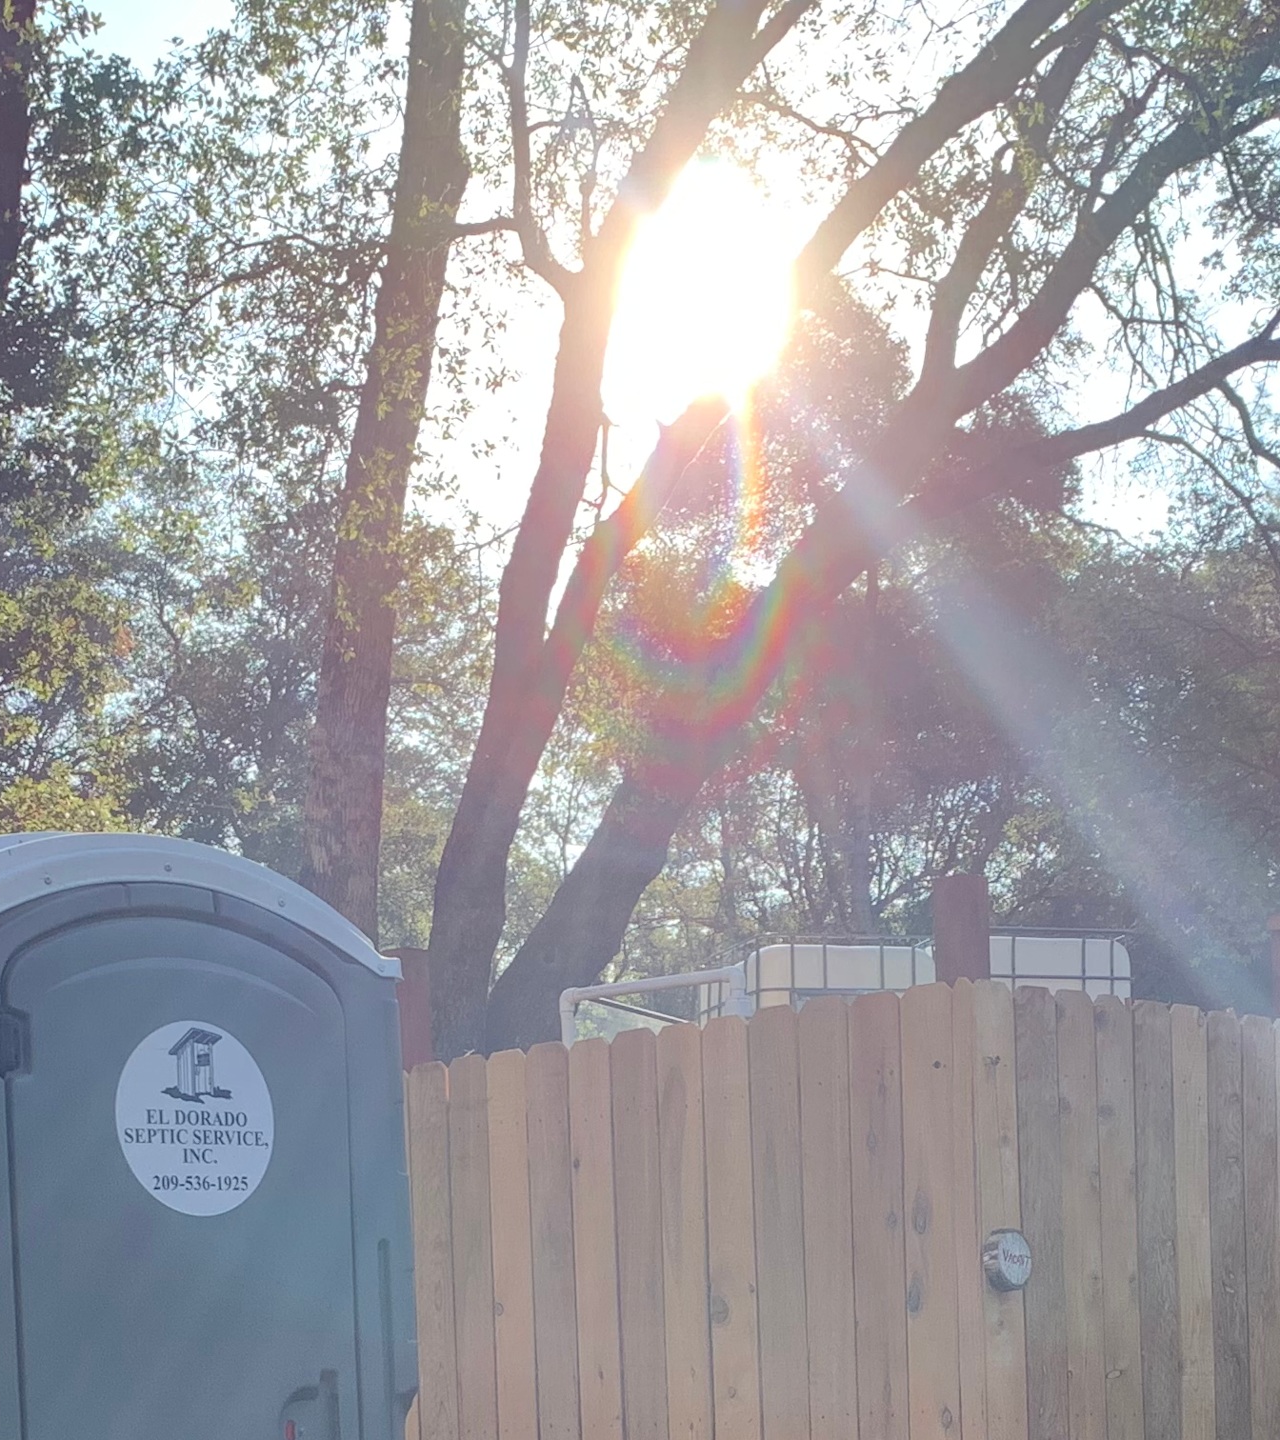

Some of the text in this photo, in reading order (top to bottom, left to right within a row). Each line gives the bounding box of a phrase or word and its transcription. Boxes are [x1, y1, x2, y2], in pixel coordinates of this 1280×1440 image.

[146, 1109, 248, 1127] EL DORADO
[124, 1128, 269, 1149] SEPTIC SERVICE,
[182, 1148, 218, 1164] INC.
[153, 1175, 249, 1191] 209-536-1925
